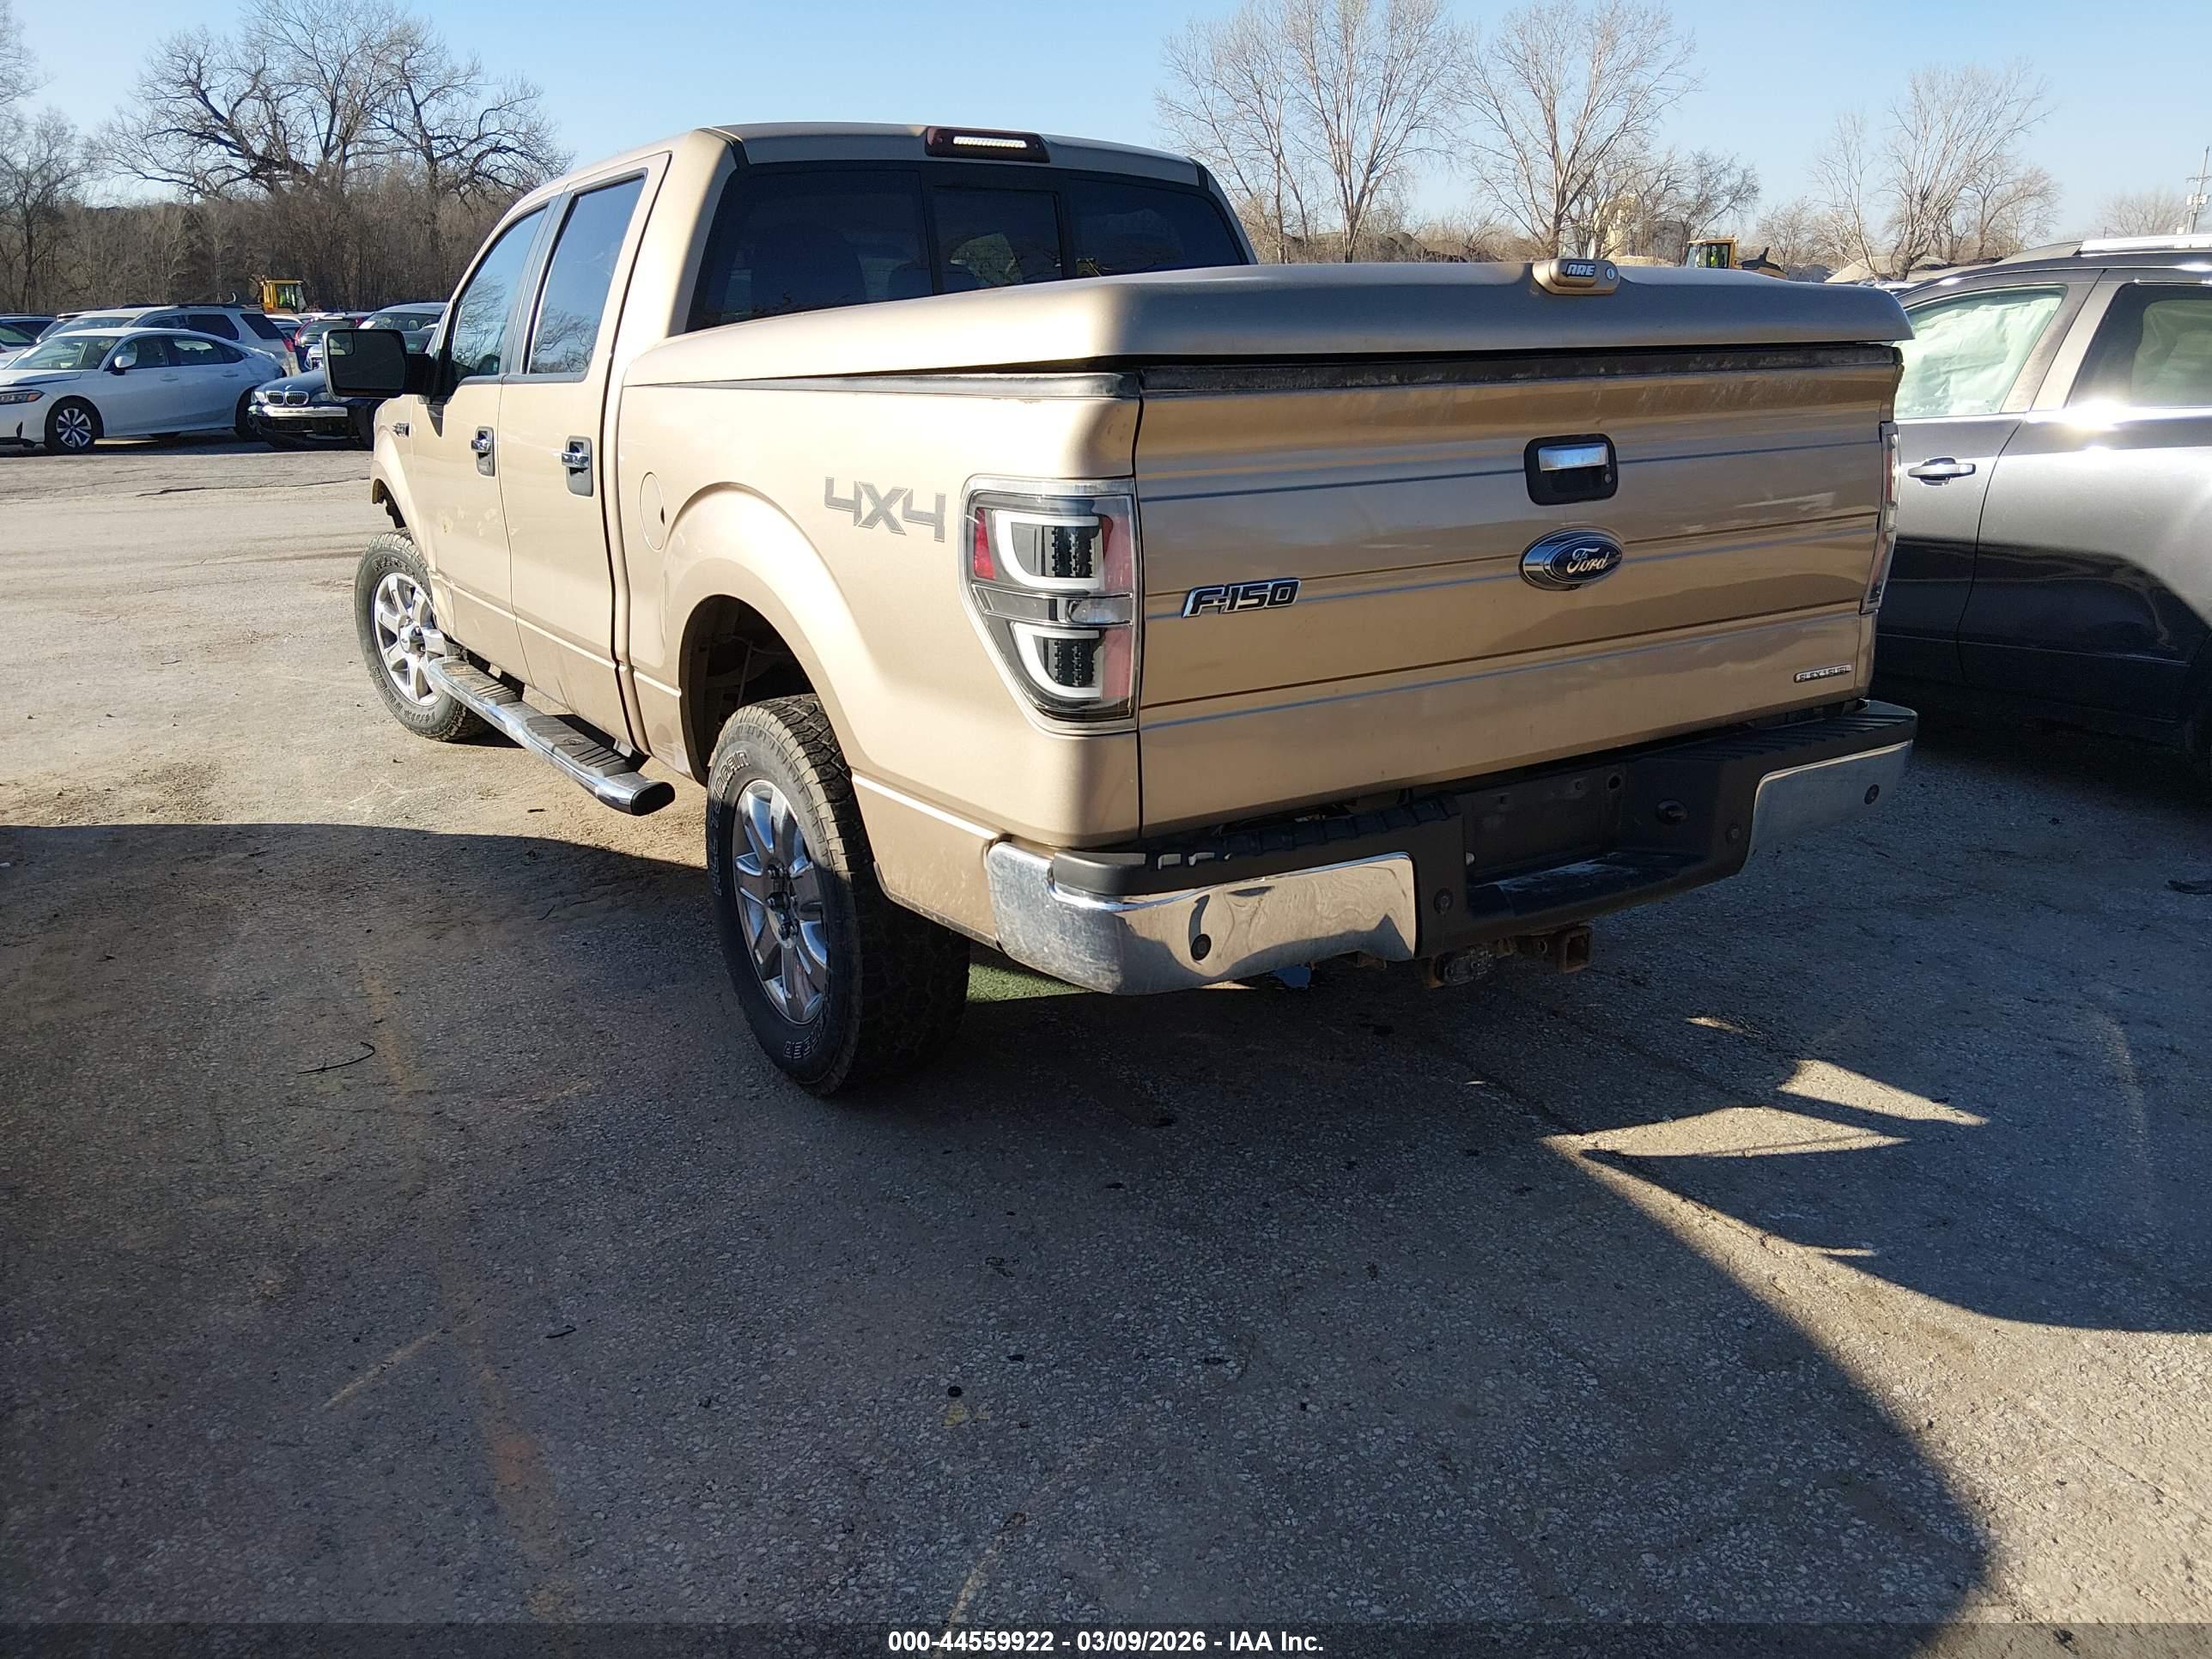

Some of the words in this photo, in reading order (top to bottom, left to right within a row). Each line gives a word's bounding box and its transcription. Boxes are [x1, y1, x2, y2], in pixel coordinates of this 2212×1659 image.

[1567, 264, 1595, 276] ARE
[824, 477, 946, 543] 4X4
[1566, 547, 1610, 574] Ford
[1182, 577, 1302, 618] F-150
